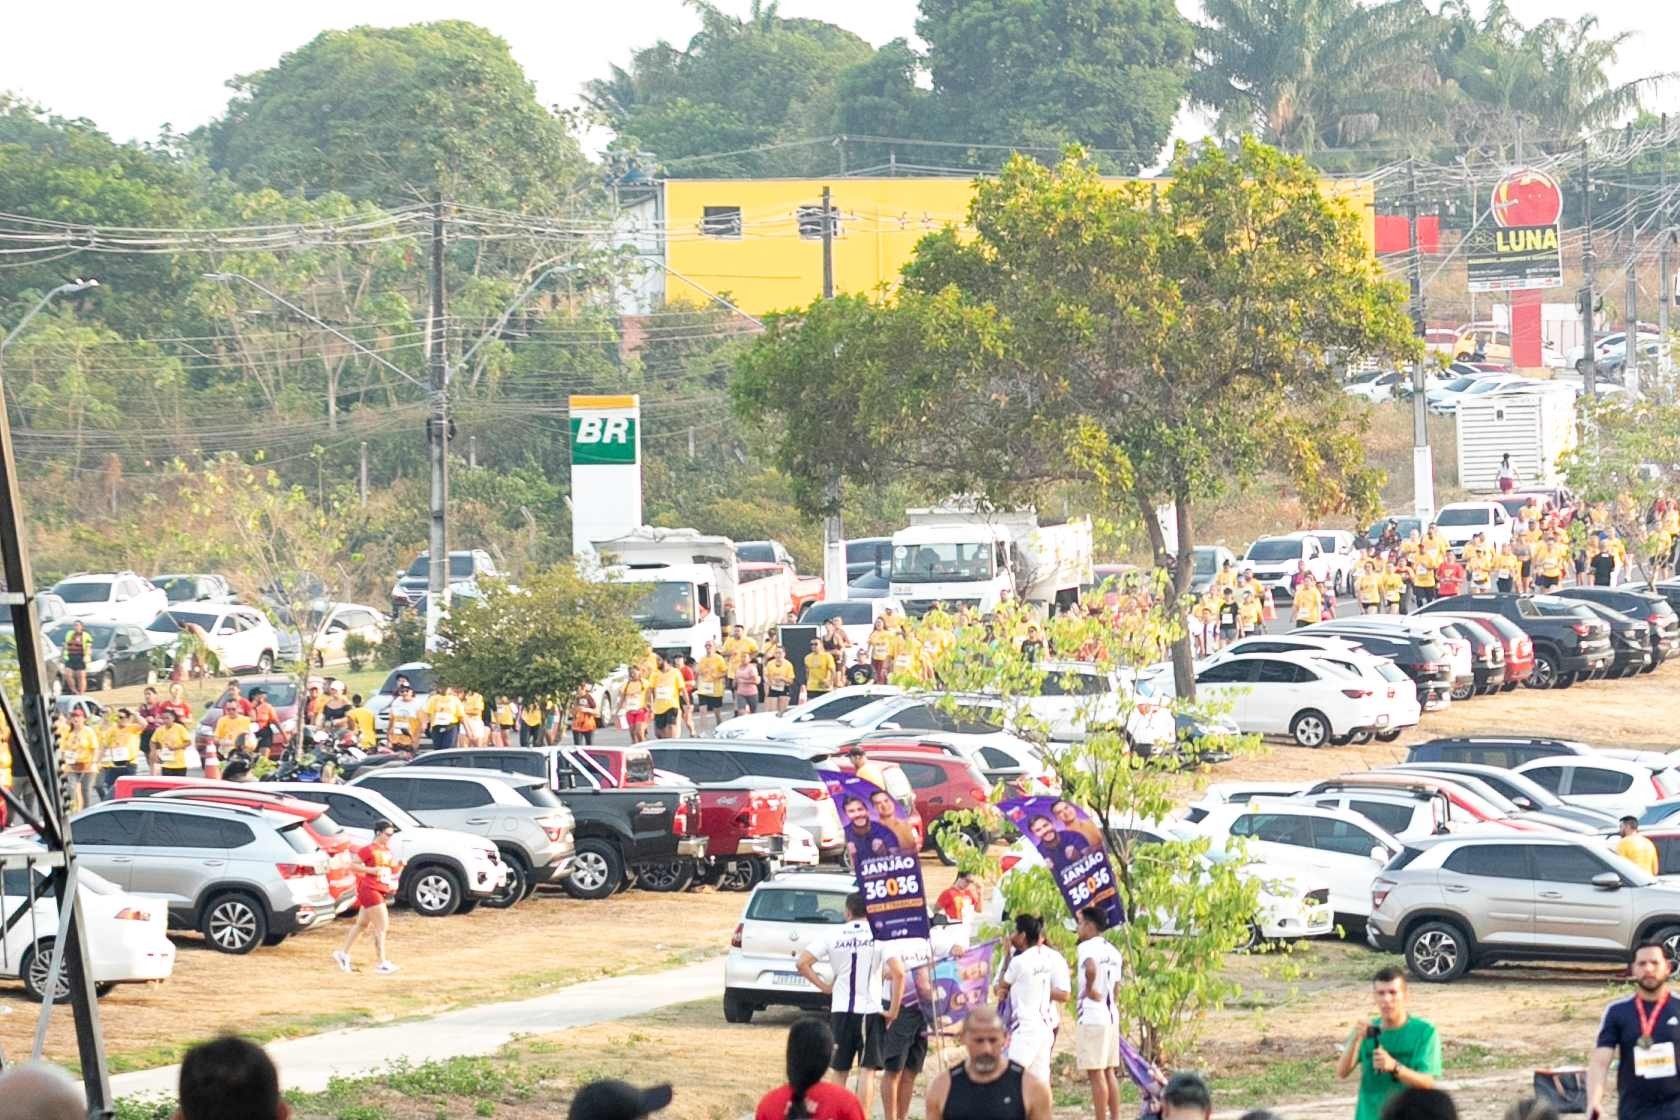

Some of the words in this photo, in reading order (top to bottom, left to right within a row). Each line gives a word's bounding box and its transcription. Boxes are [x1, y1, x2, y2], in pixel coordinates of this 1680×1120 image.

[1496, 228, 1558, 252] LUNA
[576, 417, 629, 443] BR
[861, 856, 915, 876] JANJÃO
[1062, 852, 1104, 885] JANJÃO
[864, 875, 919, 900] 36036
[1068, 867, 1110, 906] 36036
